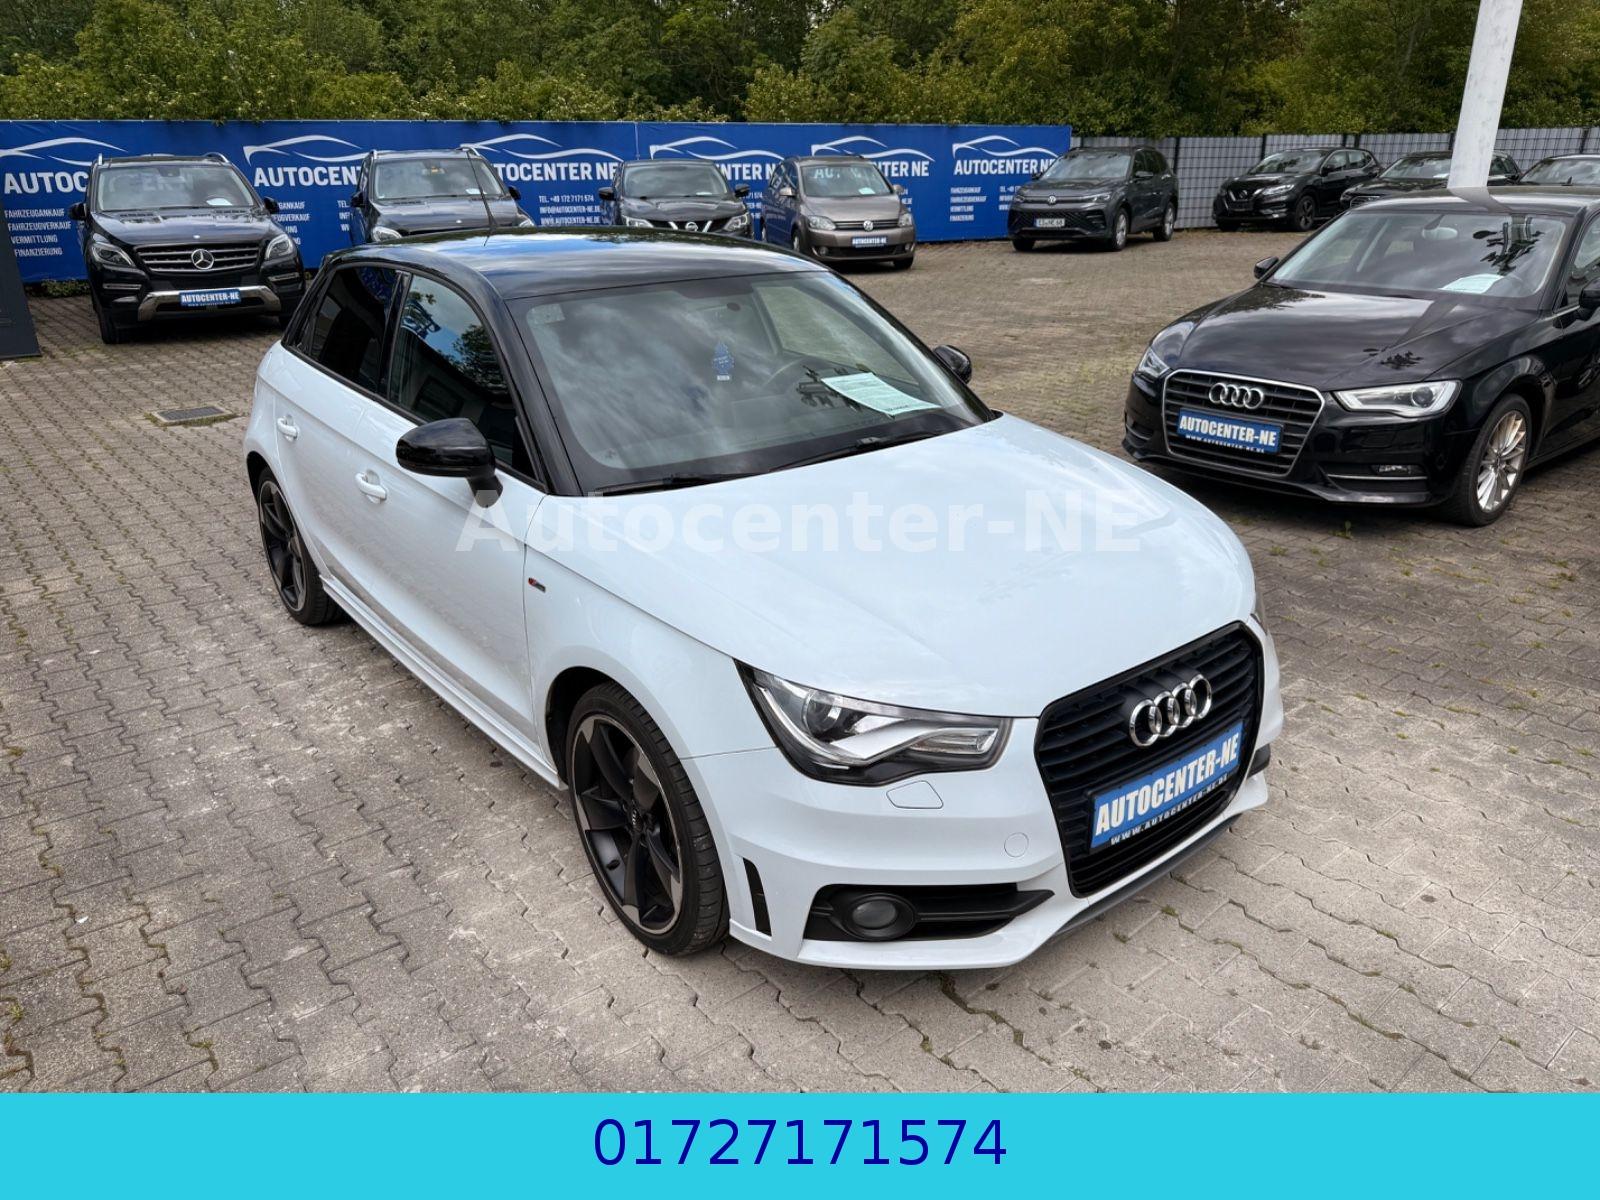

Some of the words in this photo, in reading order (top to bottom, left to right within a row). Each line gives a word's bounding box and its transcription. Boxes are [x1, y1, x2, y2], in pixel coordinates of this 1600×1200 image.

[254, 166, 361, 187] AUTOCEN
[491, 162, 592, 181] TOCENTER
[911, 161, 930, 177] NE
[953, 159, 1037, 175] AUTOCENTER
[4, 171, 89, 194] AUTOC
[11, 234, 58, 244] VERMITTLUNG
[181, 291, 240, 303] AUTOCENTER-NE
[1180, 415, 1277, 446] AUTOCENTER-NE
[1094, 731, 1240, 836] AUTOCENTER-NE
